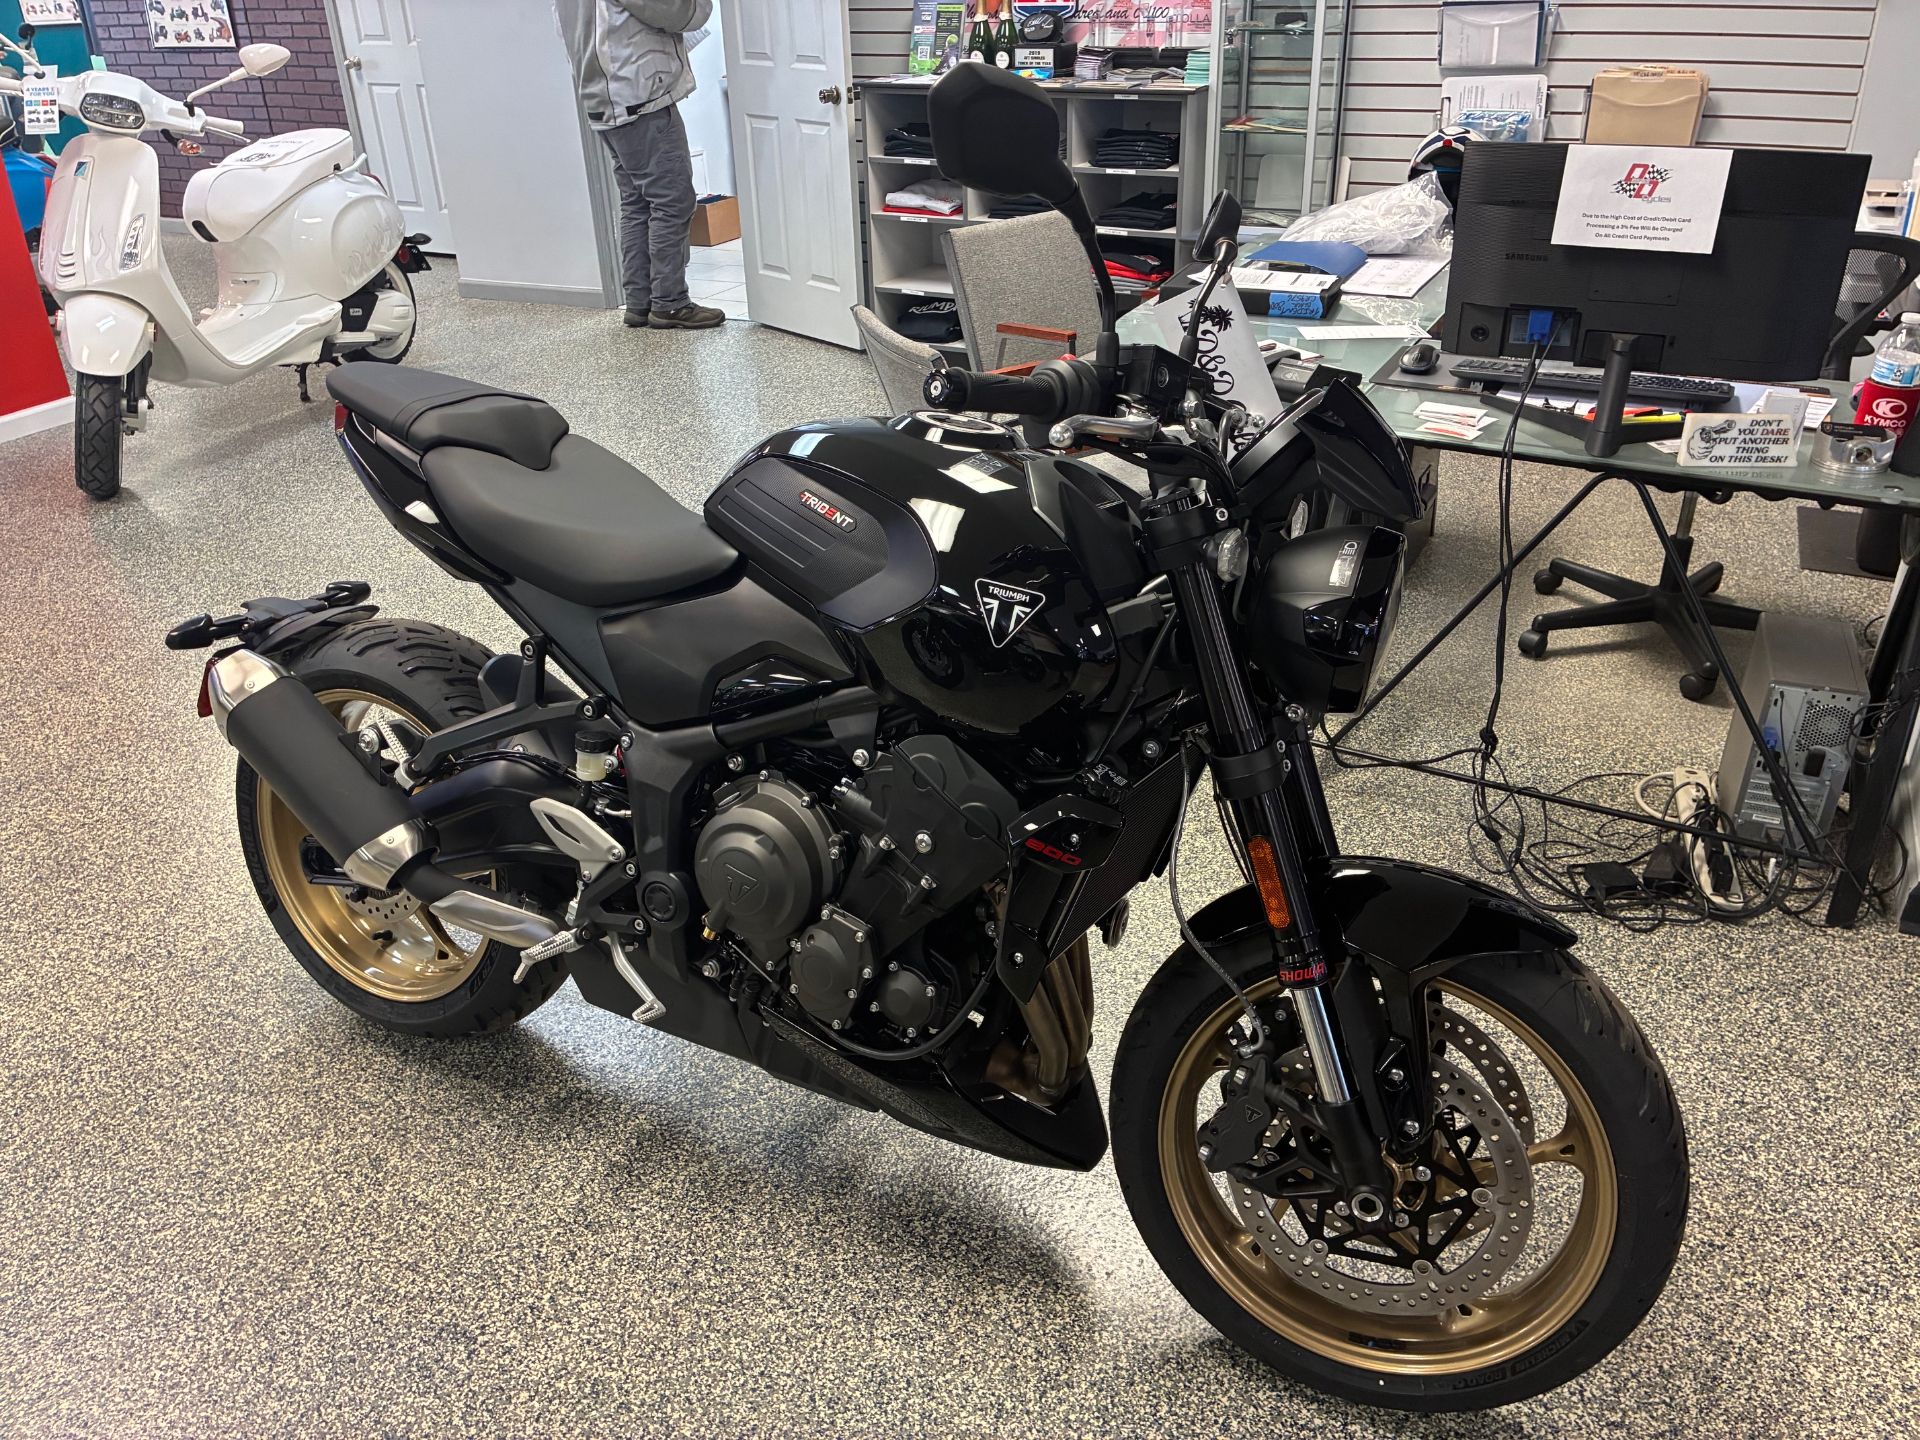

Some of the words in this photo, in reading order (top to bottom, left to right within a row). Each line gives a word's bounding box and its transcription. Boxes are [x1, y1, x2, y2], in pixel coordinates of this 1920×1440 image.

[1586, 222, 1616, 230] Processing
[1505, 253, 1549, 261] SAMSUNG
[1749, 419, 1783, 427] DON'T
[1863, 414, 1906, 428] KYMCO
[1737, 428, 1759, 436] YOU
[1760, 428, 1791, 436] DARE
[1716, 437, 1737, 445] PUT
[1739, 437, 1790, 445] ANOTHER
[1735, 446, 1769, 454] THING
[1709, 455, 1727, 463] ON
[1727, 455, 1754, 463] THIS
[1754, 455, 1789, 463] DESK!
[800, 491, 854, 527] TRIDENT
[988, 585, 1030, 603] TRIUMPH
[1024, 838, 1082, 866] 800
[1279, 962, 1325, 982] SHOWA
